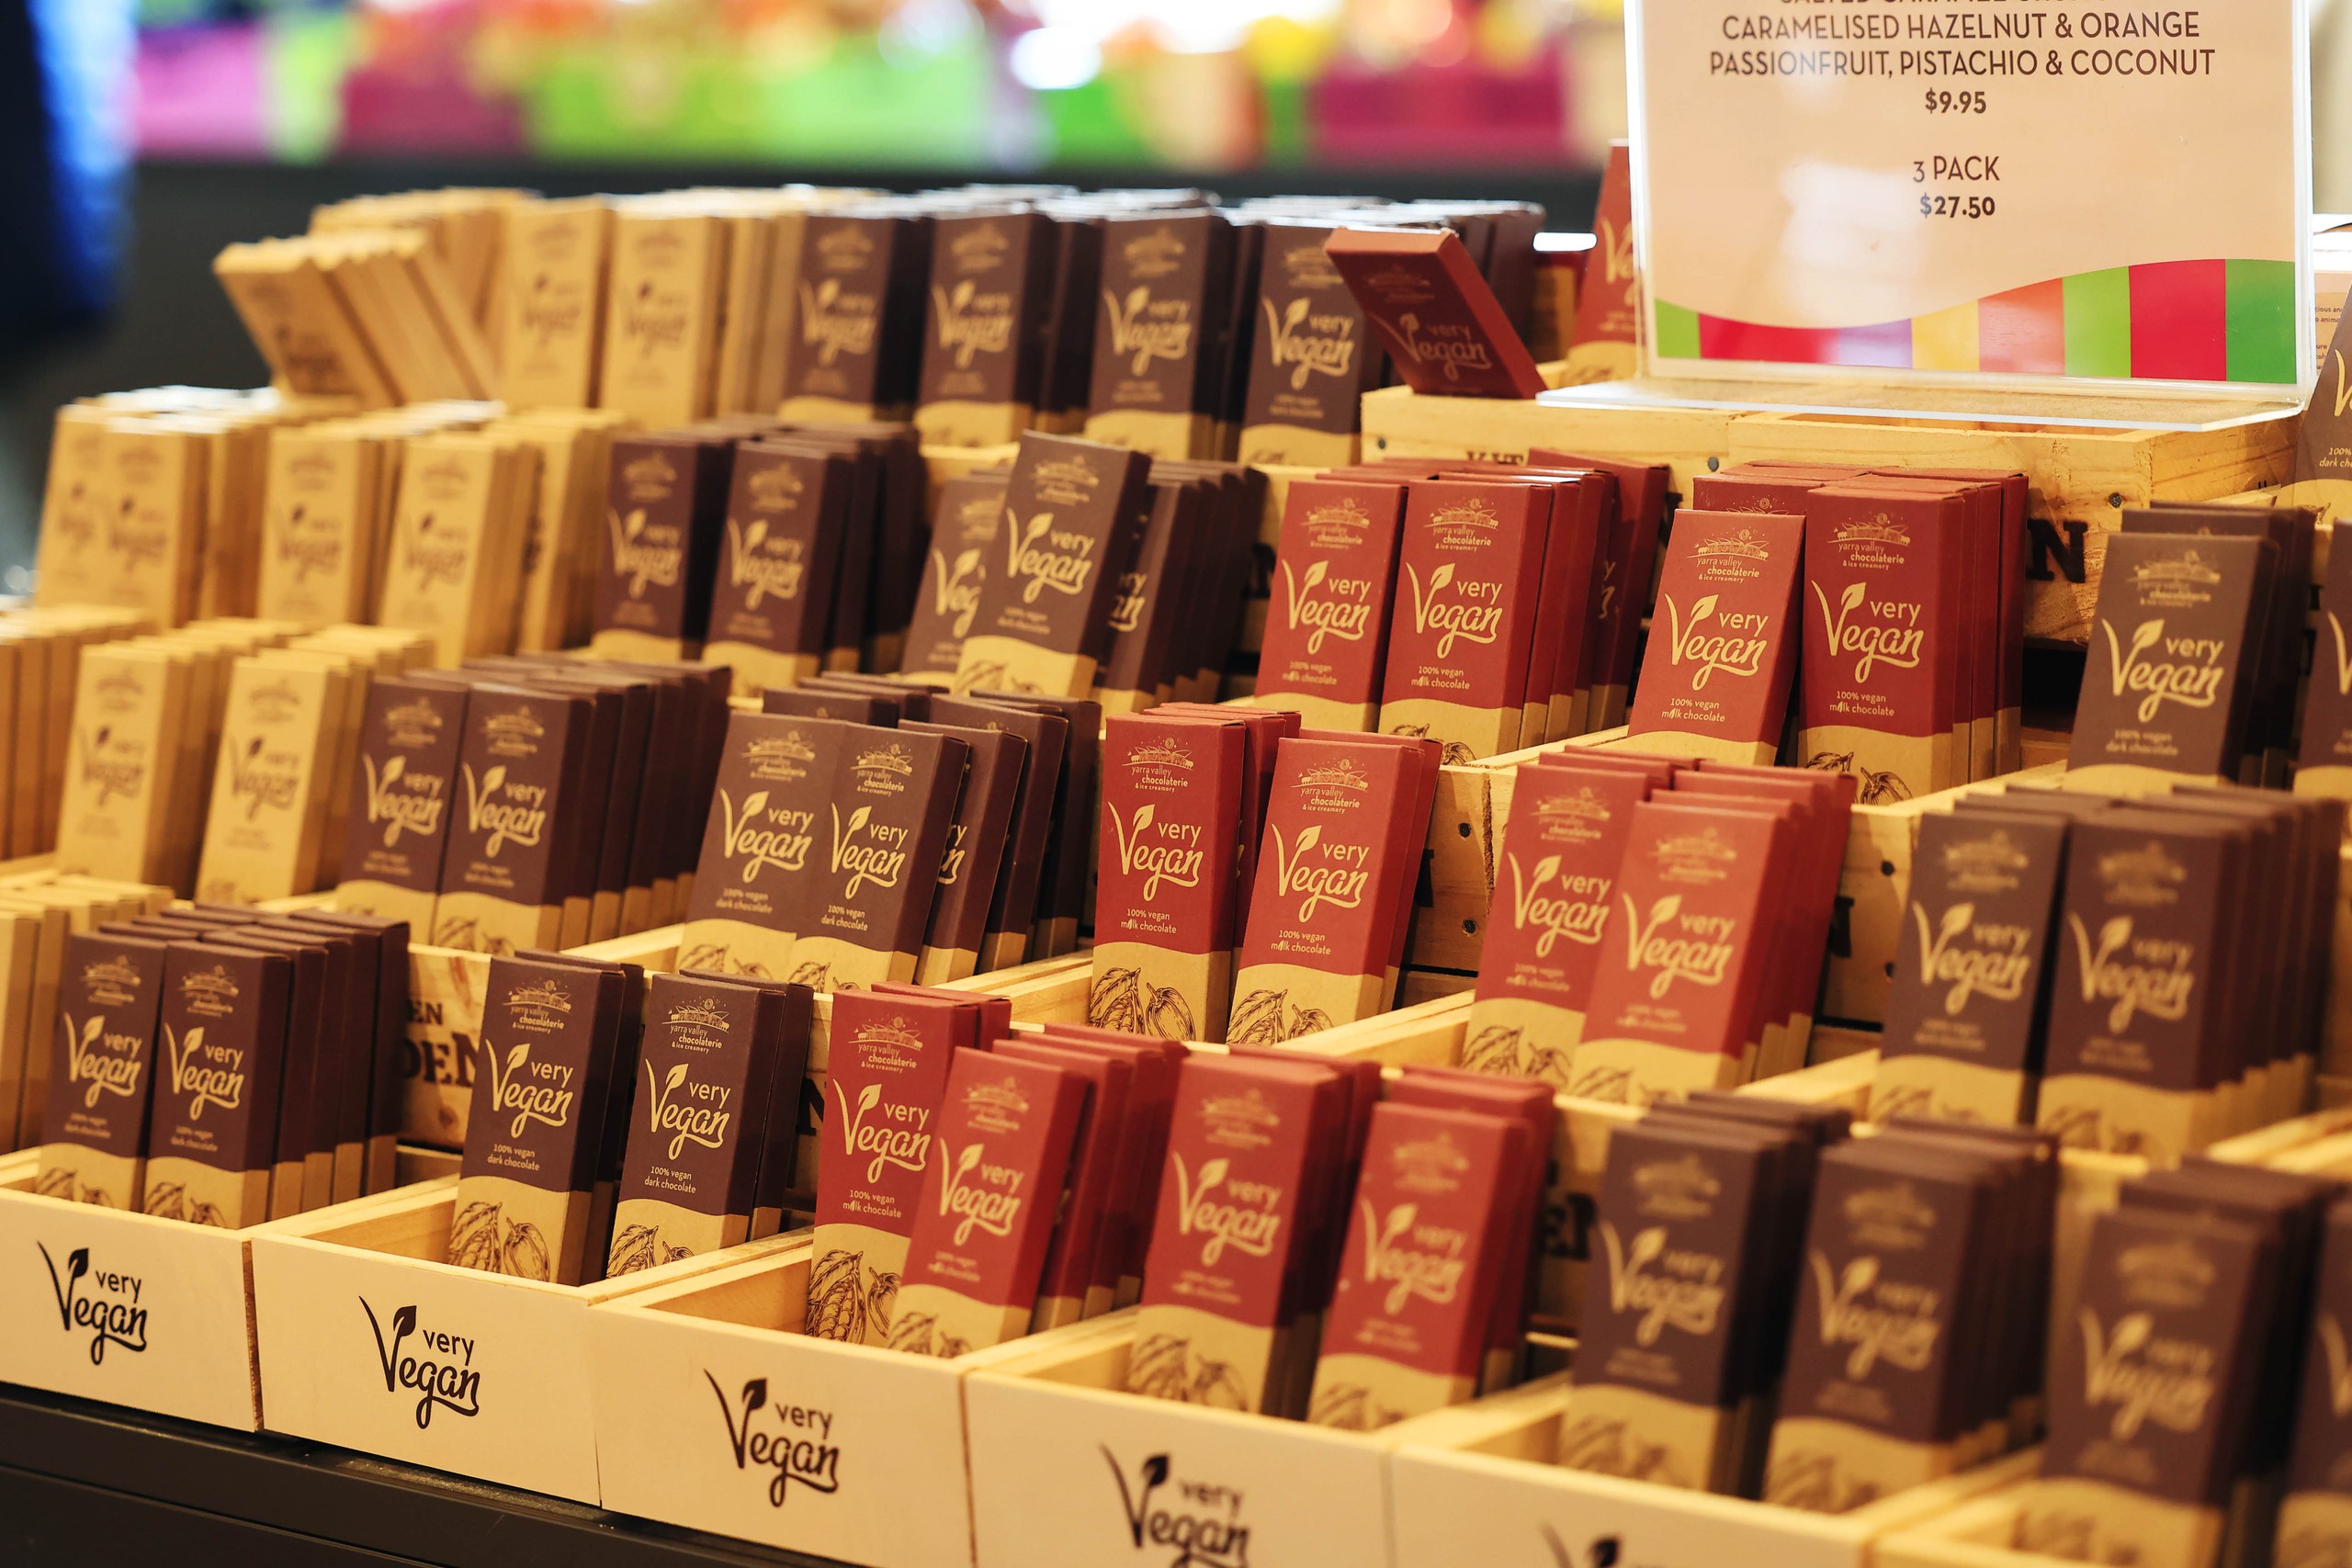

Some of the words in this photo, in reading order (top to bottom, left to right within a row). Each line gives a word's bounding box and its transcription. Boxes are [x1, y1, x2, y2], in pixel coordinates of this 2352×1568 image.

[1723, 15, 1899, 39] CARAMELISED
[1907, 14, 2047, 39] HAZELNUT
[2055, 12, 2073, 38] &
[2081, 11, 2199, 38] ORANGE
[1711, 51, 1893, 78] PASSIONFRUIT,
[1900, 50, 2038, 75] PISTACHIO
[2045, 50, 2064, 75] &
[2071, 49, 2215, 75] COCONUT
[1925, 87, 1986, 114] $9.95
[1913, 161, 1925, 183] 3
[1934, 155, 2000, 181] PACK
[1919, 192, 1996, 219] $27.50
[1006, 508, 1091, 603] Vegan
[1051, 530, 1094, 556] very
[1696, 558, 1718, 568] yarra
[1719, 556, 1743, 569] valley
[1707, 565, 1760, 578] chocolaterie
[1329, 578, 1371, 602] very
[1456, 580, 1502, 604] very
[1282, 558, 1371, 654] Vegan
[1406, 562, 1503, 659] Vegan
[1870, 600, 1921, 626] very
[1719, 611, 1769, 637] very
[1812, 581, 1924, 683] Vegan
[1665, 592, 1768, 690] Vegan
[2165, 637, 2223, 664] very
[2102, 618, 2223, 722] Vegan
[1670, 698, 1692, 707] 100%
[1694, 701, 1720, 711] vegan
[1837, 691, 1860, 701] 100%
[1860, 694, 1886, 705] vegan
[1851, 703, 1894, 716] chocolate
[1683, 709, 1725, 722] chocolate
[1131, 766, 1150, 776] yarra
[1150, 764, 1172, 778] valley
[1141, 773, 1189, 787] chocolaterie
[1300, 787, 1320, 797] yarra
[1321, 785, 1344, 799] valley
[1310, 795, 1360, 808] chocolaterie
[768, 807, 813, 833] very
[720, 788, 812, 883] Vegan
[870, 824, 908, 846] very
[1158, 822, 1202, 847] very
[831, 803, 908, 899] Vegan
[1108, 801, 1204, 901] Vegan
[1322, 841, 1369, 868] very
[1272, 824, 1369, 923] Vegan
[1561, 874, 1611, 901] very
[1126, 908, 1147, 918] 100%
[1148, 911, 1170, 922] vegan
[1508, 852, 1611, 958] Vegan
[1139, 920, 1177, 933] chocolate
[1278, 930, 1300, 940] 100%
[1302, 932, 1326, 943] vegan
[1680, 913, 1735, 939] very
[1291, 942, 1331, 954] chocolate
[1623, 892, 1734, 999] Vegan
[104, 1032, 142, 1055] very
[670, 1024, 688, 1034] yarra
[688, 1024, 708, 1039] valley
[679, 1033, 722, 1049] chocolaterie
[63, 1012, 141, 1109] Vegan
[204, 1043, 243, 1066] very
[164, 1022, 243, 1121] Vegan
[531, 1061, 573, 1088] very
[485, 1039, 573, 1138] Vegan
[689, 1081, 730, 1110] very
[645, 1058, 729, 1160] Vegan
[884, 1102, 930, 1129] very
[833, 1078, 931, 1183] Vegan
[644, 1176, 660, 1187] dark
[661, 1179, 696, 1193] chocolate
[650, 1166, 670, 1176] 100%
[671, 1170, 692, 1181] vegan
[981, 1162, 1023, 1193] very
[850, 1190, 870, 1200] 100%
[872, 1194, 895, 1205] vegan
[940, 1137, 1021, 1246] Vegan
[863, 1202, 902, 1218] chocolate
[1173, 1152, 1281, 1266] Vegan
[96, 1270, 141, 1303] very
[37, 1241, 147, 1365] Vegan
[423, 1329, 474, 1366] very
[358, 1295, 481, 1429] Vegan
[775, 1401, 832, 1438] very
[704, 1369, 839, 1506] Vegan
[1099, 1443, 1251, 1568] Vegan
